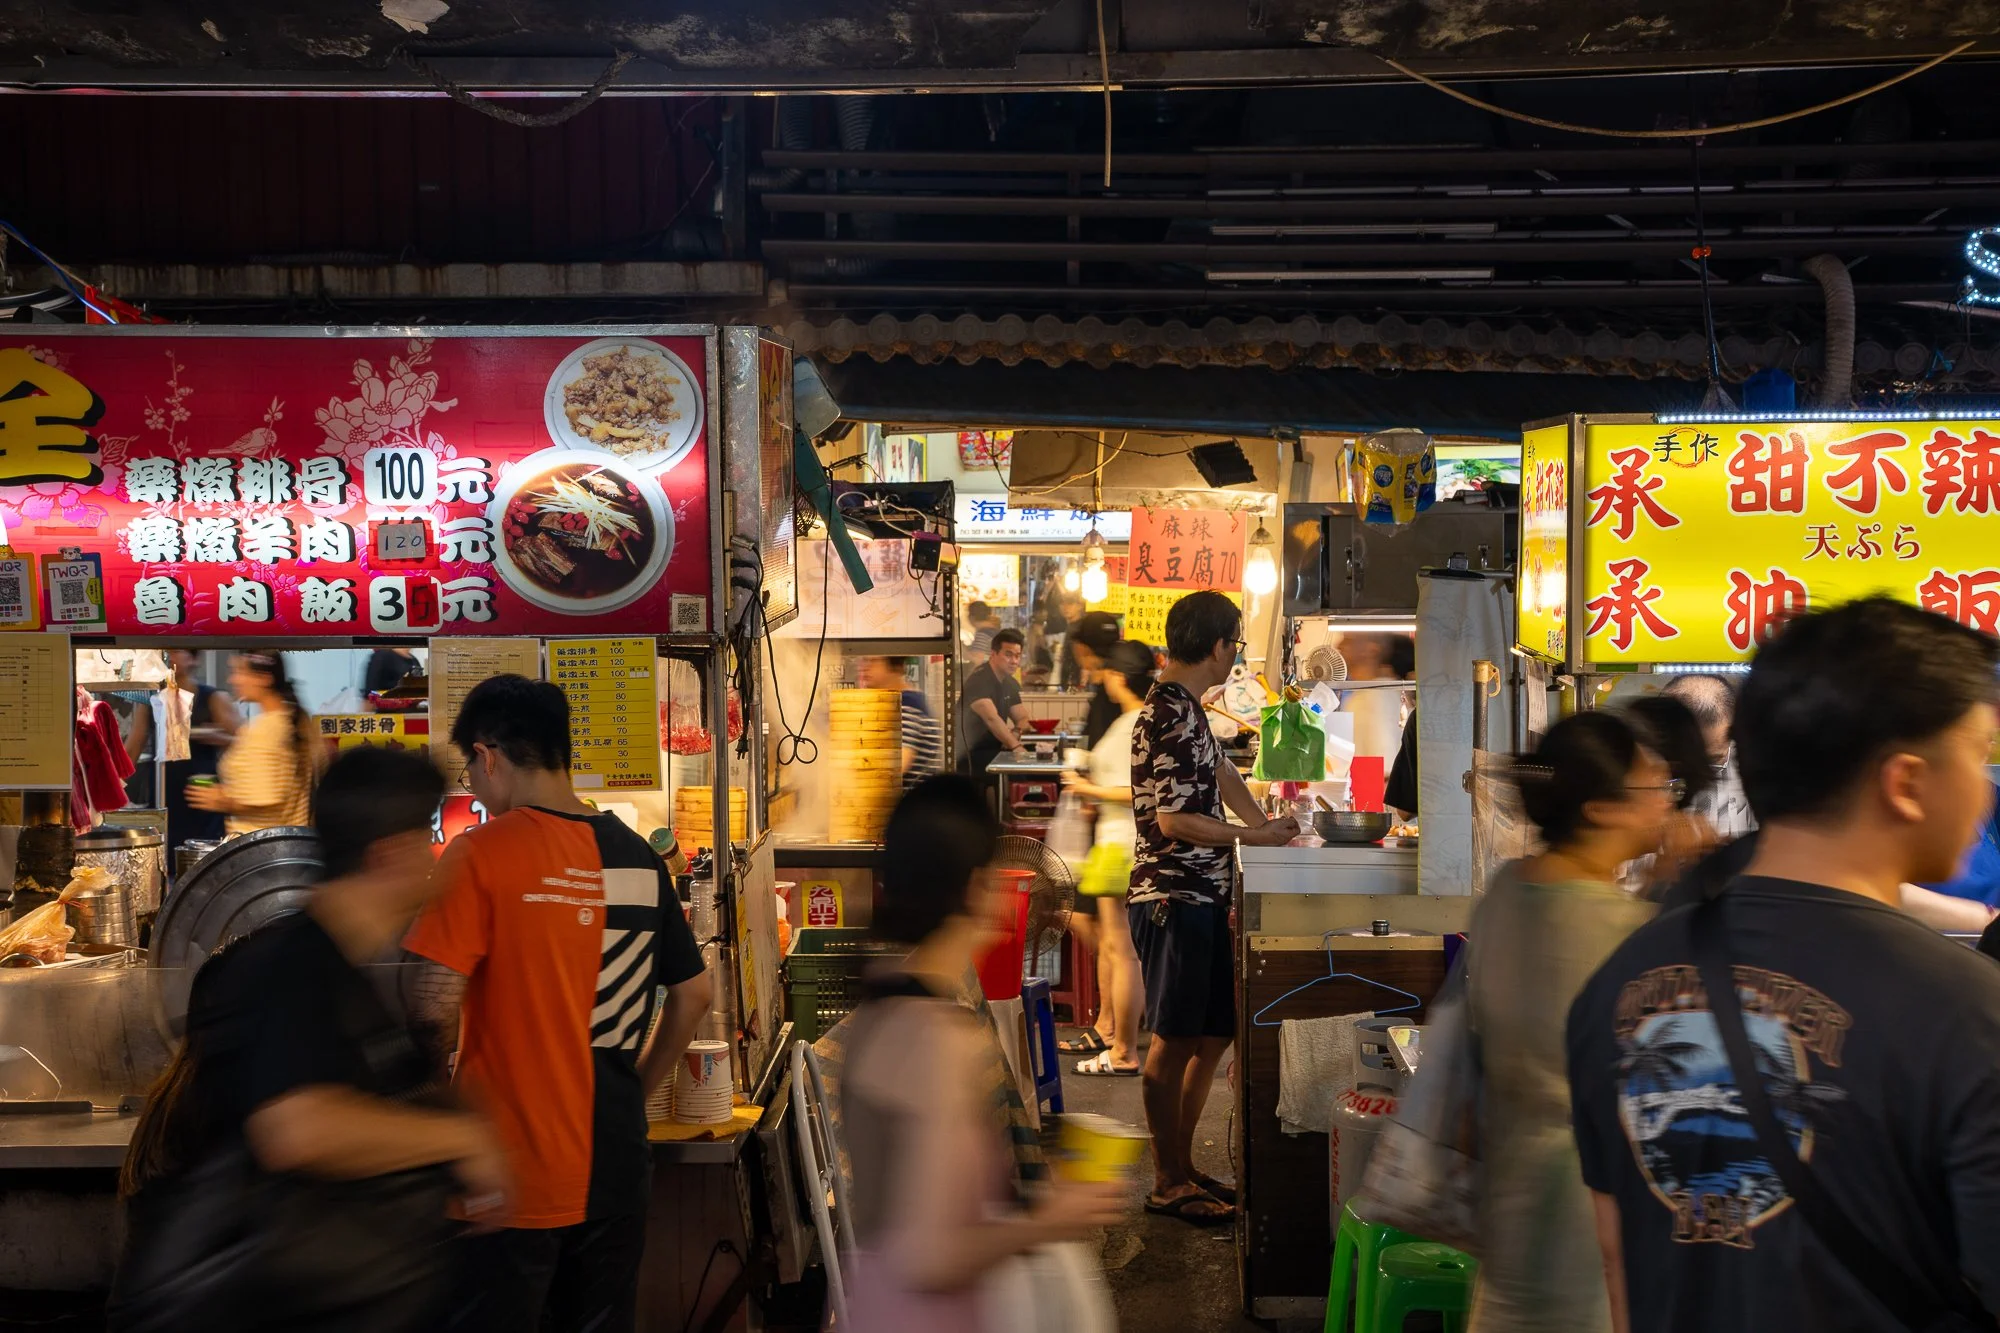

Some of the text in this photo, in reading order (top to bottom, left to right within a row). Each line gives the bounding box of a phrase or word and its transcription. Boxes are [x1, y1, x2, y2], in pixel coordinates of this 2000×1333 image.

[1652, 432, 1720, 463] 手作
[375, 452, 424, 500] 100
[437, 457, 496, 504] 元
[1586, 448, 1681, 541] 承
[385, 535, 422, 551] 120
[439, 517, 497, 564] 元
[1160, 514, 1214, 541] 麻辣
[1804, 523, 1922, 560] 天ぷら
[49, 565, 89, 579] TWQR
[441, 576, 499, 623] 元
[1586, 558, 1681, 651] 承
[320, 717, 396, 734] 劉家排骨
